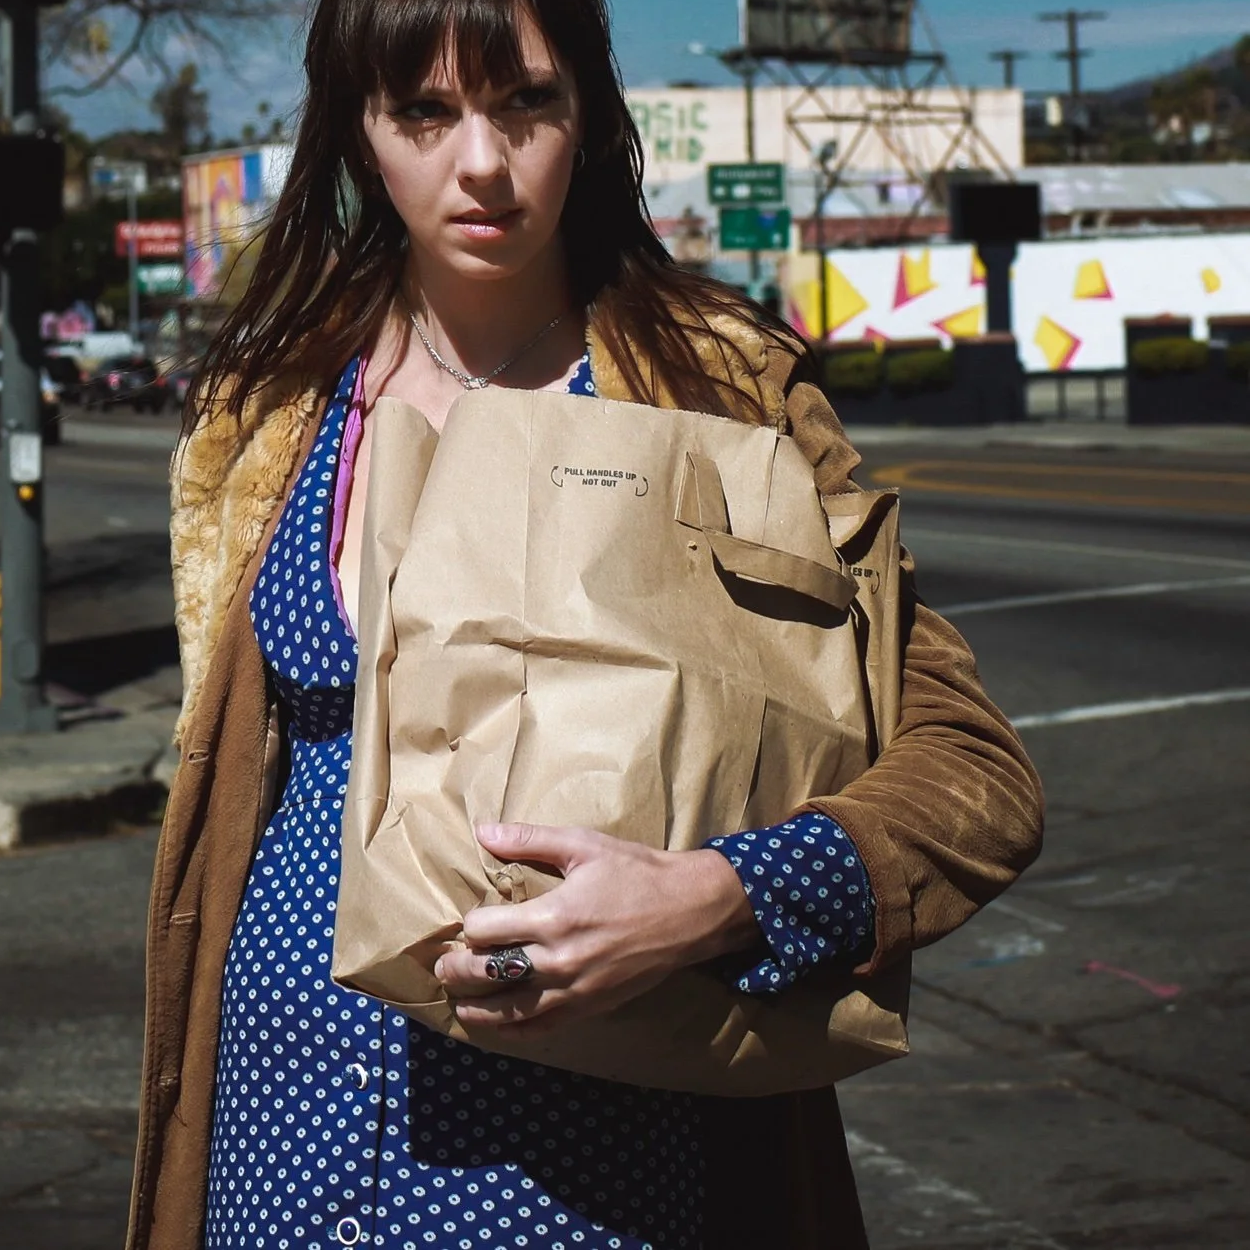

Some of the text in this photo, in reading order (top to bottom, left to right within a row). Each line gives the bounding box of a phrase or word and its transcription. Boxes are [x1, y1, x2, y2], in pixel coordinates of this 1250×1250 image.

[564, 467, 637, 481] PULL HANDLES UP
[582, 478, 618, 488] NOT OUT
[864, 568, 873, 578] UP
